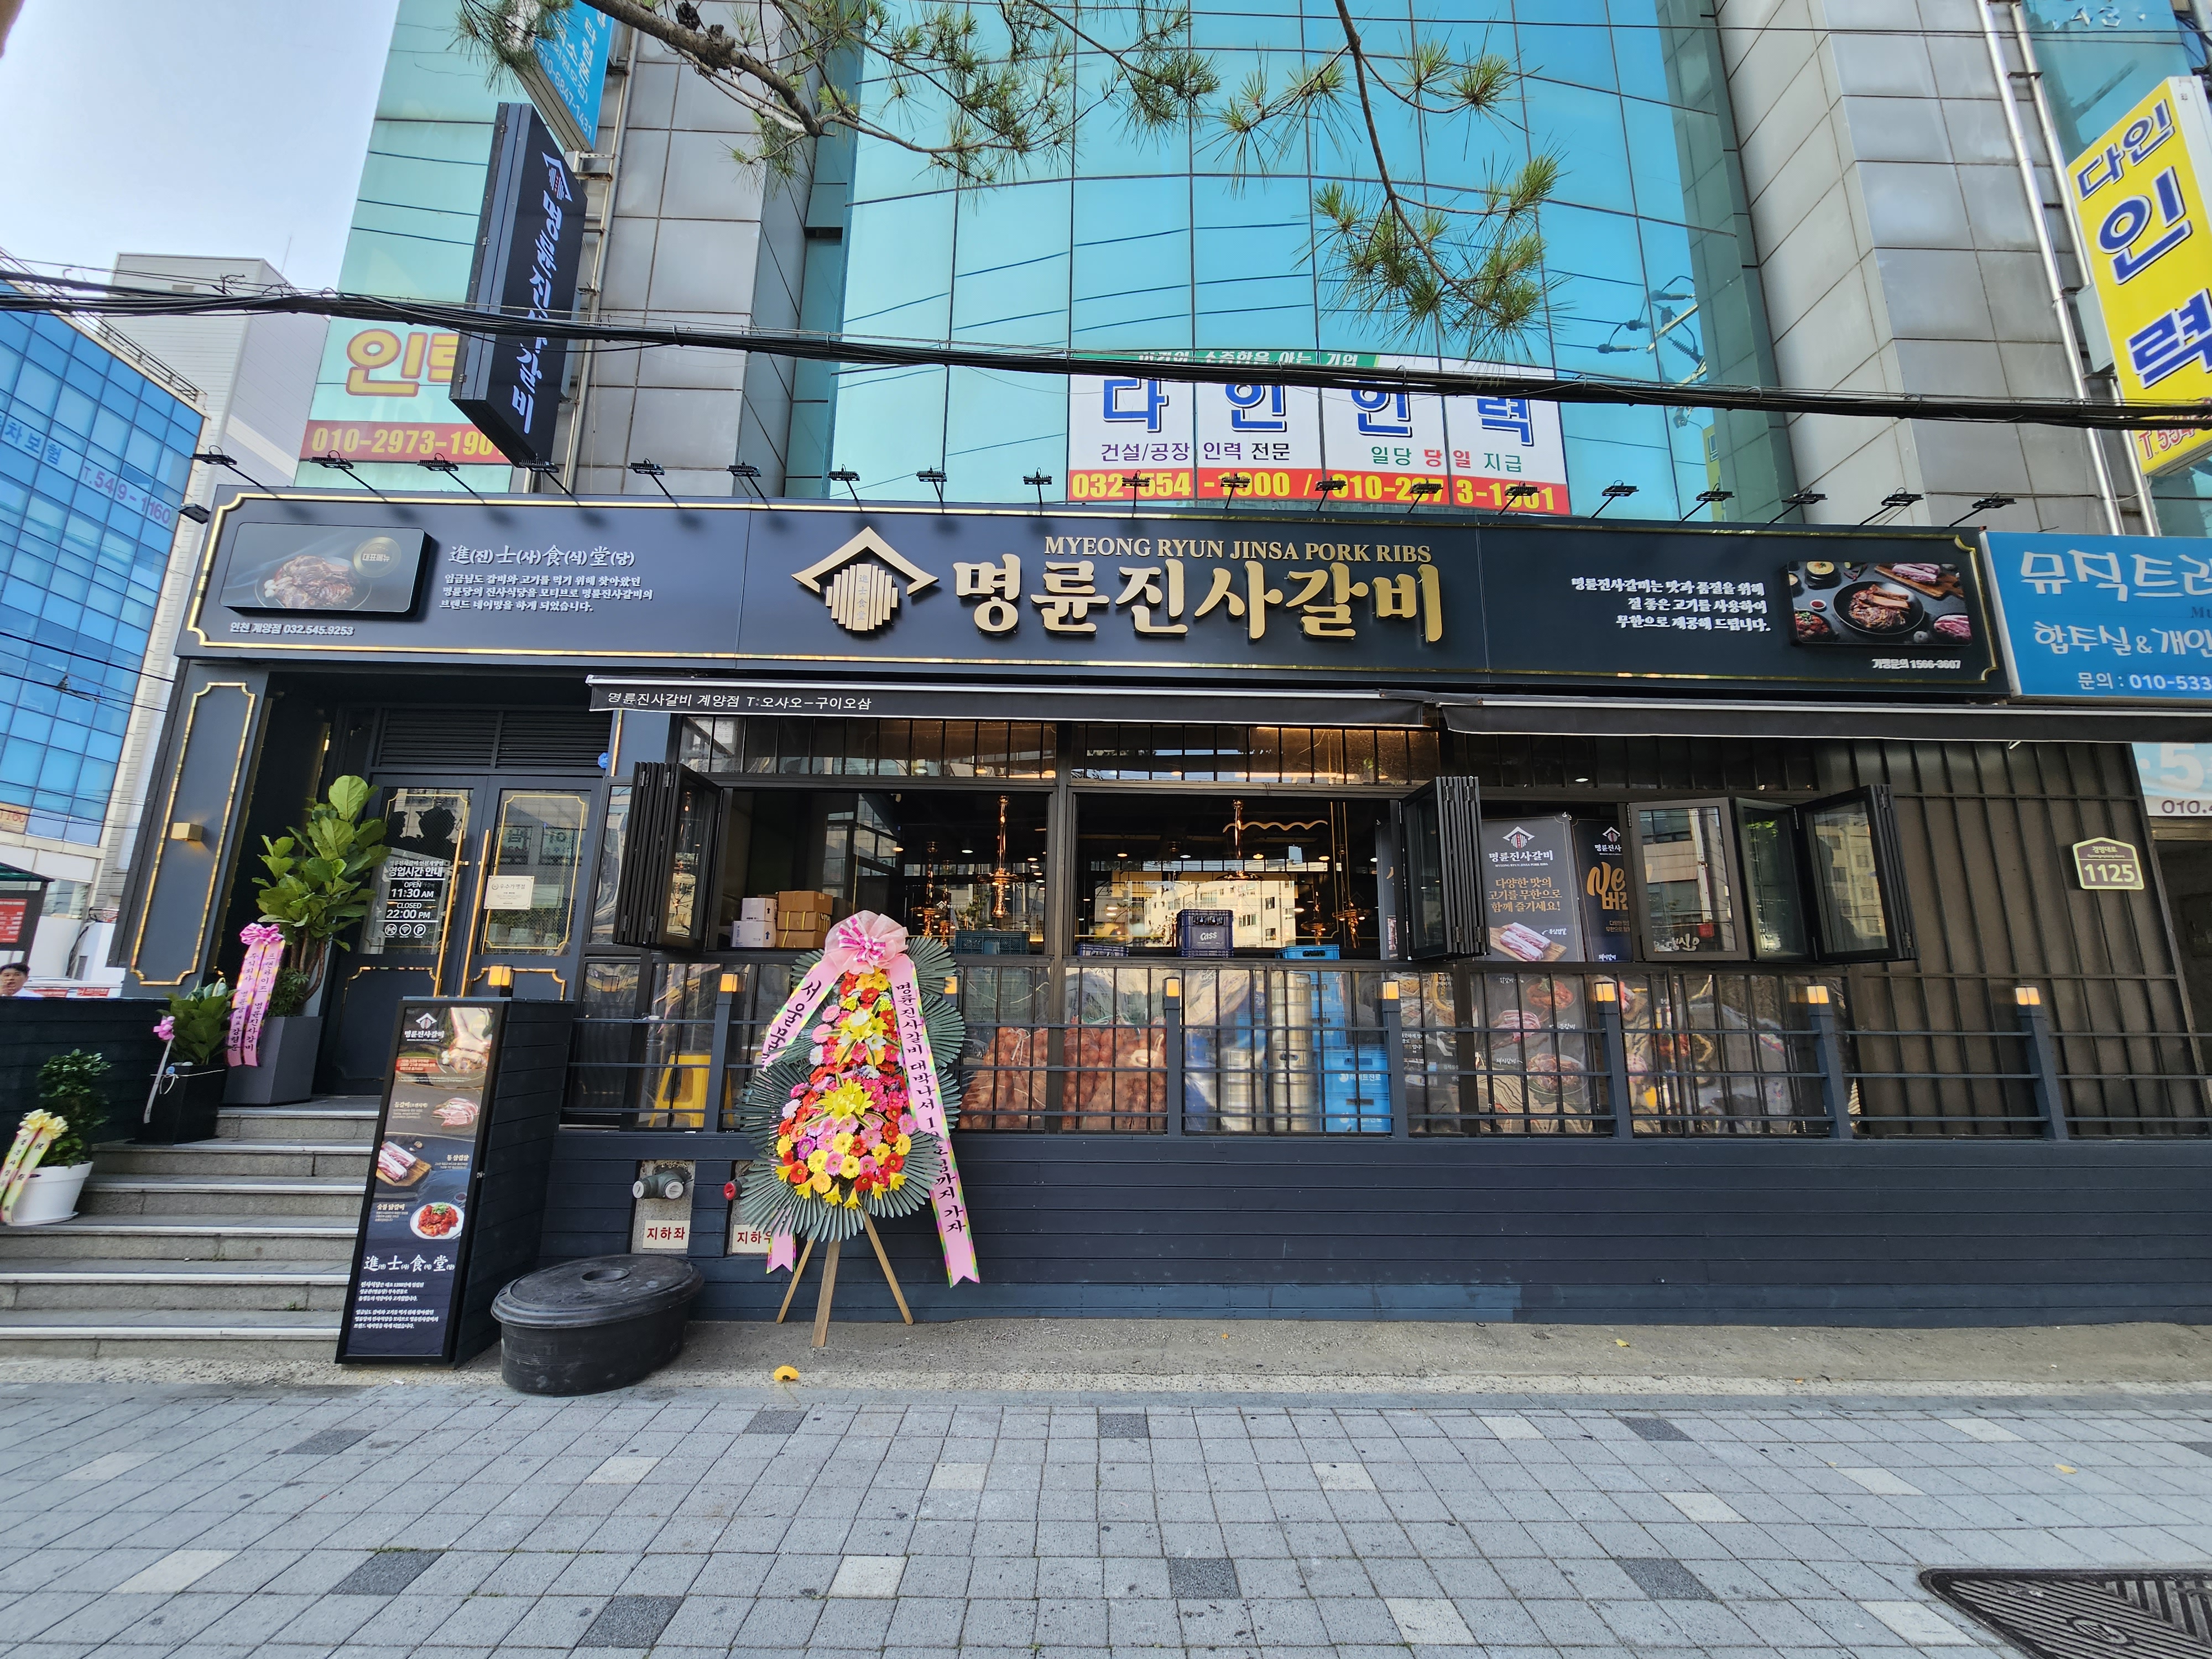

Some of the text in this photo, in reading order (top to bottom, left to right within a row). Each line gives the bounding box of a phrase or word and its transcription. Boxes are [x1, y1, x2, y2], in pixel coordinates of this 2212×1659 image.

[2076, 98, 2176, 201] 다인
[311, 427, 504, 458] 010-2973-190
[1101, 442, 1291, 462] 건설/공장 인력 전문
[1371, 446, 1412, 466] 일당
[1484, 451, 1522, 473] 지급
[362, 553, 390, 562] 대표메뉴
[1045, 536, 1432, 563] MYEONG RYUN JINSA PORK RIBS
[445, 573, 641, 588] 임금님도 갈비와 고기를 먹기 위해 찾아왔던
[1571, 577, 1765, 597] 명륜진사갈비는 맛과 품질을 위해
[442, 586, 654, 601] 명륜당의 진사식당을 모티브로 명륜진사갈비의
[953, 553, 1443, 643] 명륜진사갈비
[439, 599, 594, 613] 브랜드 네이밍을 하게 되었습니다.
[1644, 597, 1671, 612] 좋은
[1672, 598, 1712, 613] 고기를
[1713, 599, 1768, 614] 사용하여
[230, 621, 356, 637] 인천 계양점 032.545.9253
[1616, 614, 1771, 633] 무한으로 제공해 드립니다.
[2136, 635, 2153, 654] &
[1872, 658, 1910, 670] 가맹문의
[2078, 672, 2114, 690] 문의
[608, 692, 691, 707] 명륜진사갈비
[697, 695, 740, 709] 계양점
[1489, 849, 1553, 862] 명륜진사갈비
[2092, 846, 2118, 854] 경명대로
[388, 866, 443, 878] 영업시간 안내
[2084, 864, 2135, 883] 1125
[1495, 876, 1552, 888] 다양한 맛의
[392, 888, 420, 898] 11:30
[1488, 889, 1562, 900] 고기를 무한으로
[386, 909, 416, 919] 22:00
[1491, 900, 1561, 912] 함께 즐기세요!
[895, 982, 924, 1056] 명륜진사갈비
[404, 1030, 445, 1039] 명륜진사갈비
[944, 1205, 967, 1233] 가자
[646, 1226, 686, 1240] 지하좌
